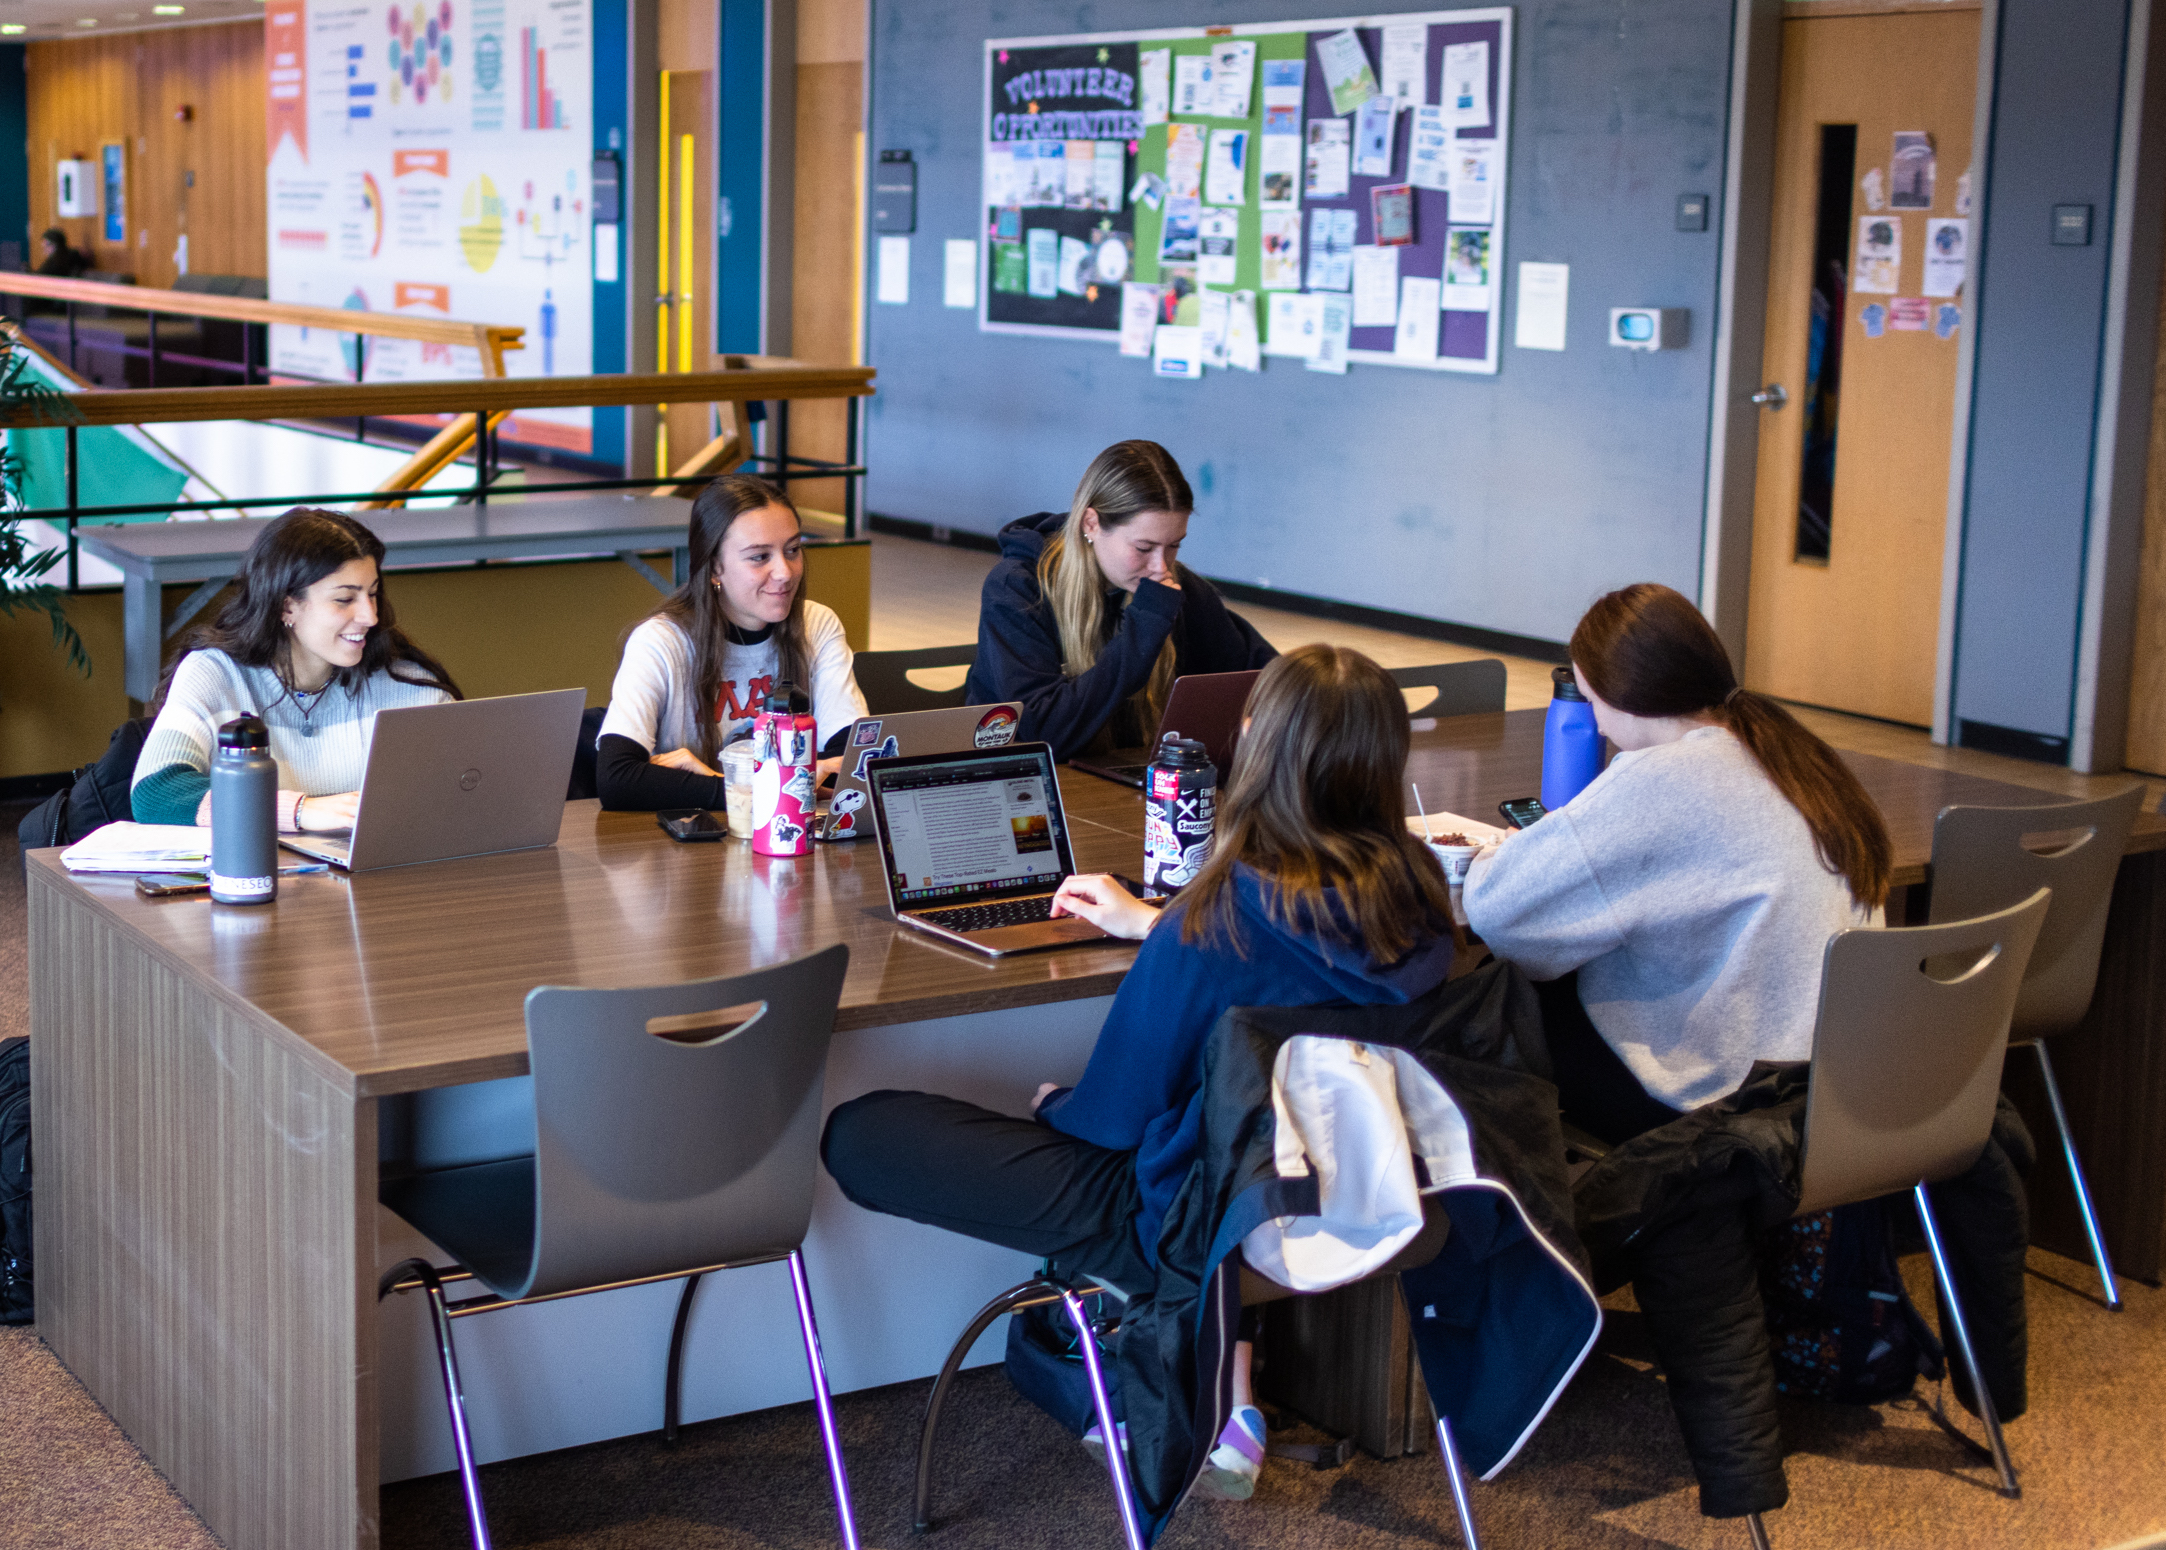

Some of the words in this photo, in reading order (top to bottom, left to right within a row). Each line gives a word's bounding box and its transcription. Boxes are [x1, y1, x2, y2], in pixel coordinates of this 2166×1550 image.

[1004, 67, 1134, 107] VOLUNTEER
[994, 110, 1147, 139] OPPORTUNITIES
[977, 732, 1012, 742] MONTAUK
[1200, 798, 1209, 808] ON
[218, 876, 272, 890] ENESEO
